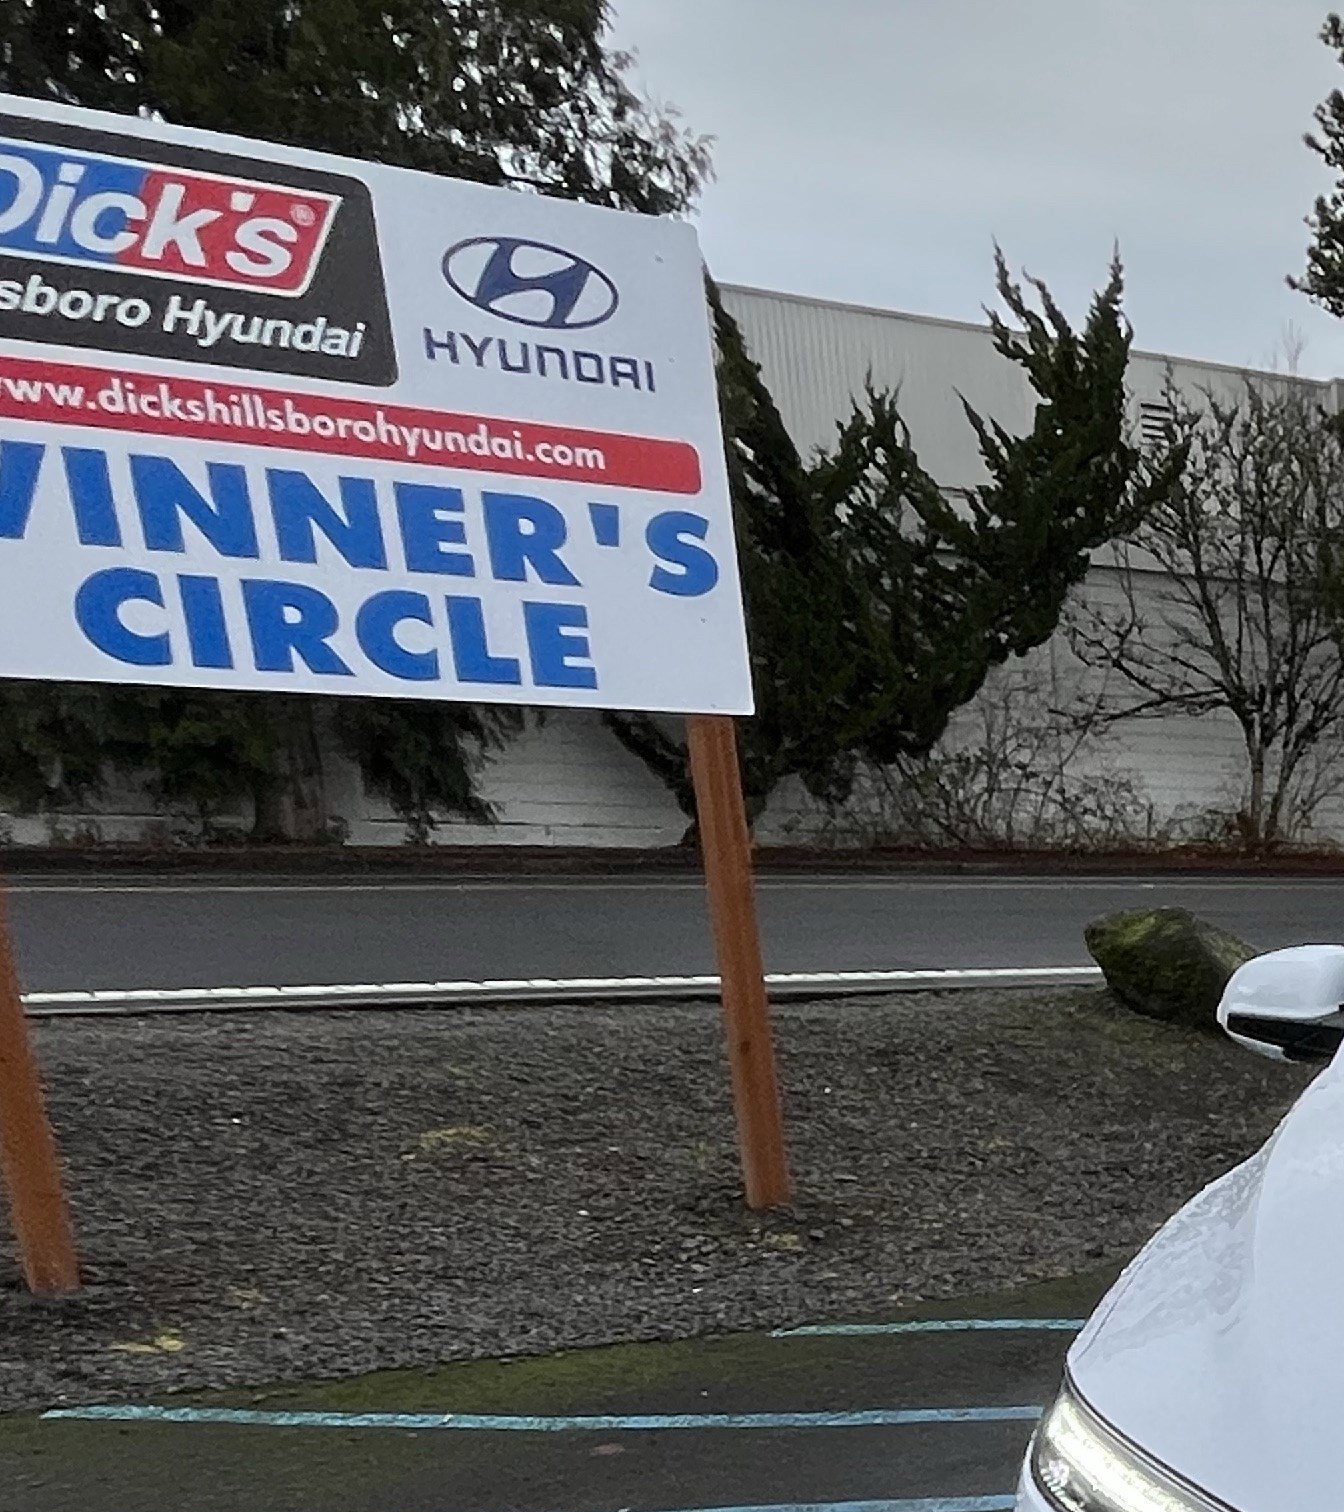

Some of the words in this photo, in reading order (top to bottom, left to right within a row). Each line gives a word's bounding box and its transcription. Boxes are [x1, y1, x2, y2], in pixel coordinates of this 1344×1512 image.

[162, 295, 366, 358] Hyundai
[422, 327, 656, 392] HYUNDAI
[0, 377, 606, 470] ww.dickshillsborohyundai.com
[74, 566, 598, 690] CIRCLE
